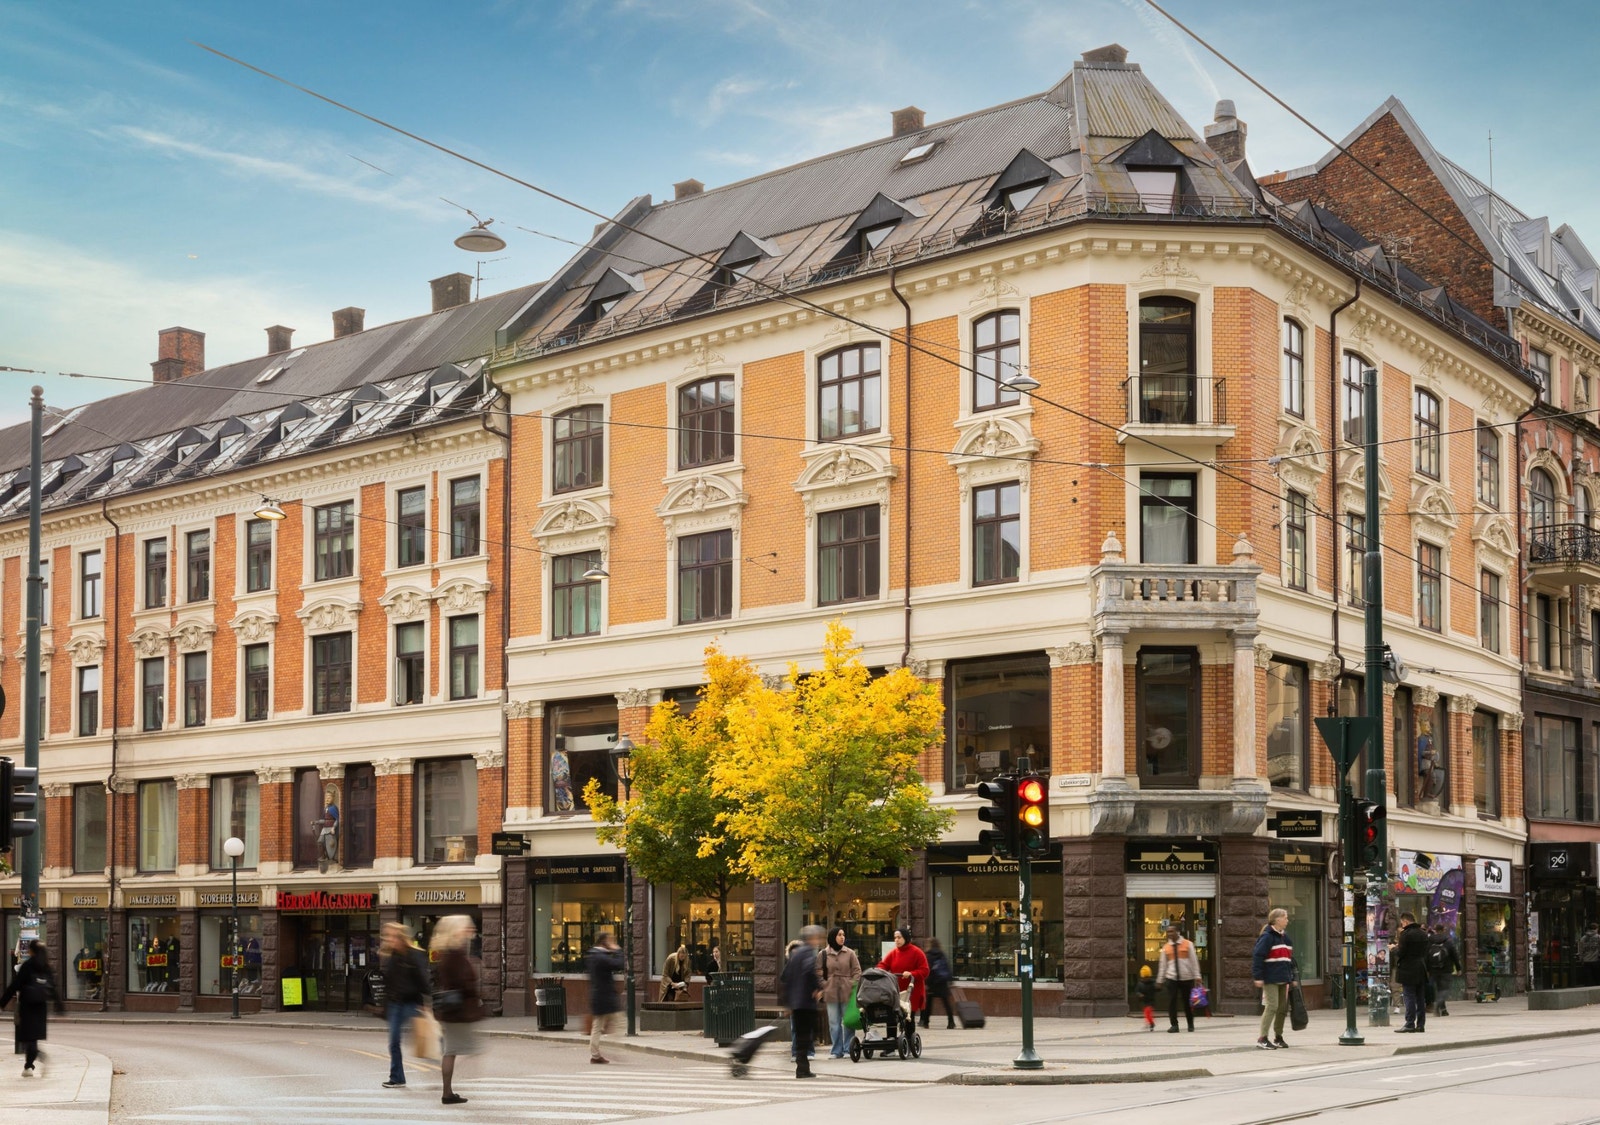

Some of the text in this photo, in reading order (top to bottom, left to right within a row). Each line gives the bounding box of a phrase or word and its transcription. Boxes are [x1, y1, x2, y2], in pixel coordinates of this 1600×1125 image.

[1551, 853, 1566, 868] 26
[967, 864, 1020, 873] GULLBORGEN
[1140, 863, 1205, 871] GULLBORGEN
[72, 895, 98, 906] DRESSER
[200, 893, 259, 904] STOREHEREKLÆR
[414, 890, 465, 902] FRITIDSKLÆR
